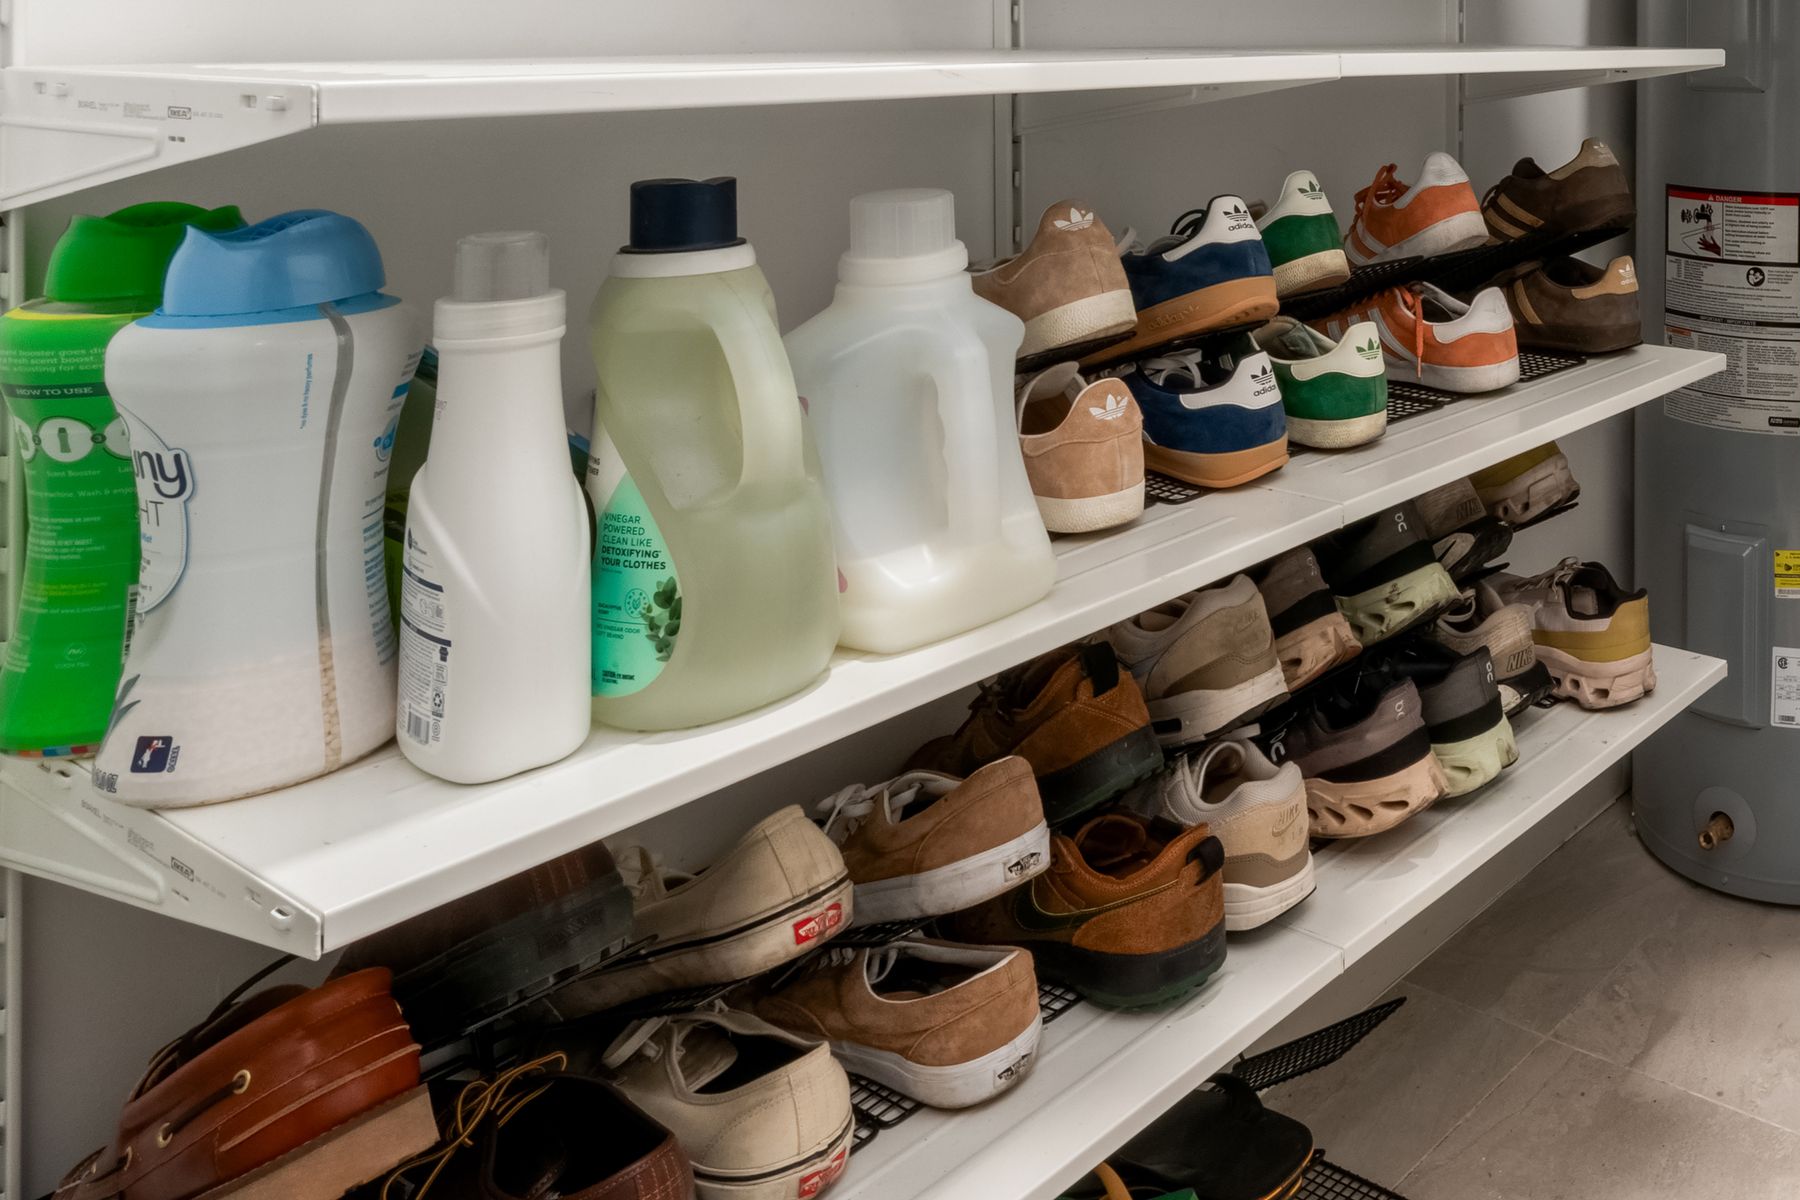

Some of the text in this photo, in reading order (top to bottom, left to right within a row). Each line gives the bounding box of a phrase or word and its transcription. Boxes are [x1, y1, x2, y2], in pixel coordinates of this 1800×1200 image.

[1715, 194, 1742, 203] DANGER
[16, 386, 94, 396] HOW TO USE
[604, 512, 641, 524] VINEGAR
[603, 523, 646, 536] POWERED
[602, 534, 653, 548] CLEAN LIKE
[601, 556, 667, 570] YOUR CLOTHES
